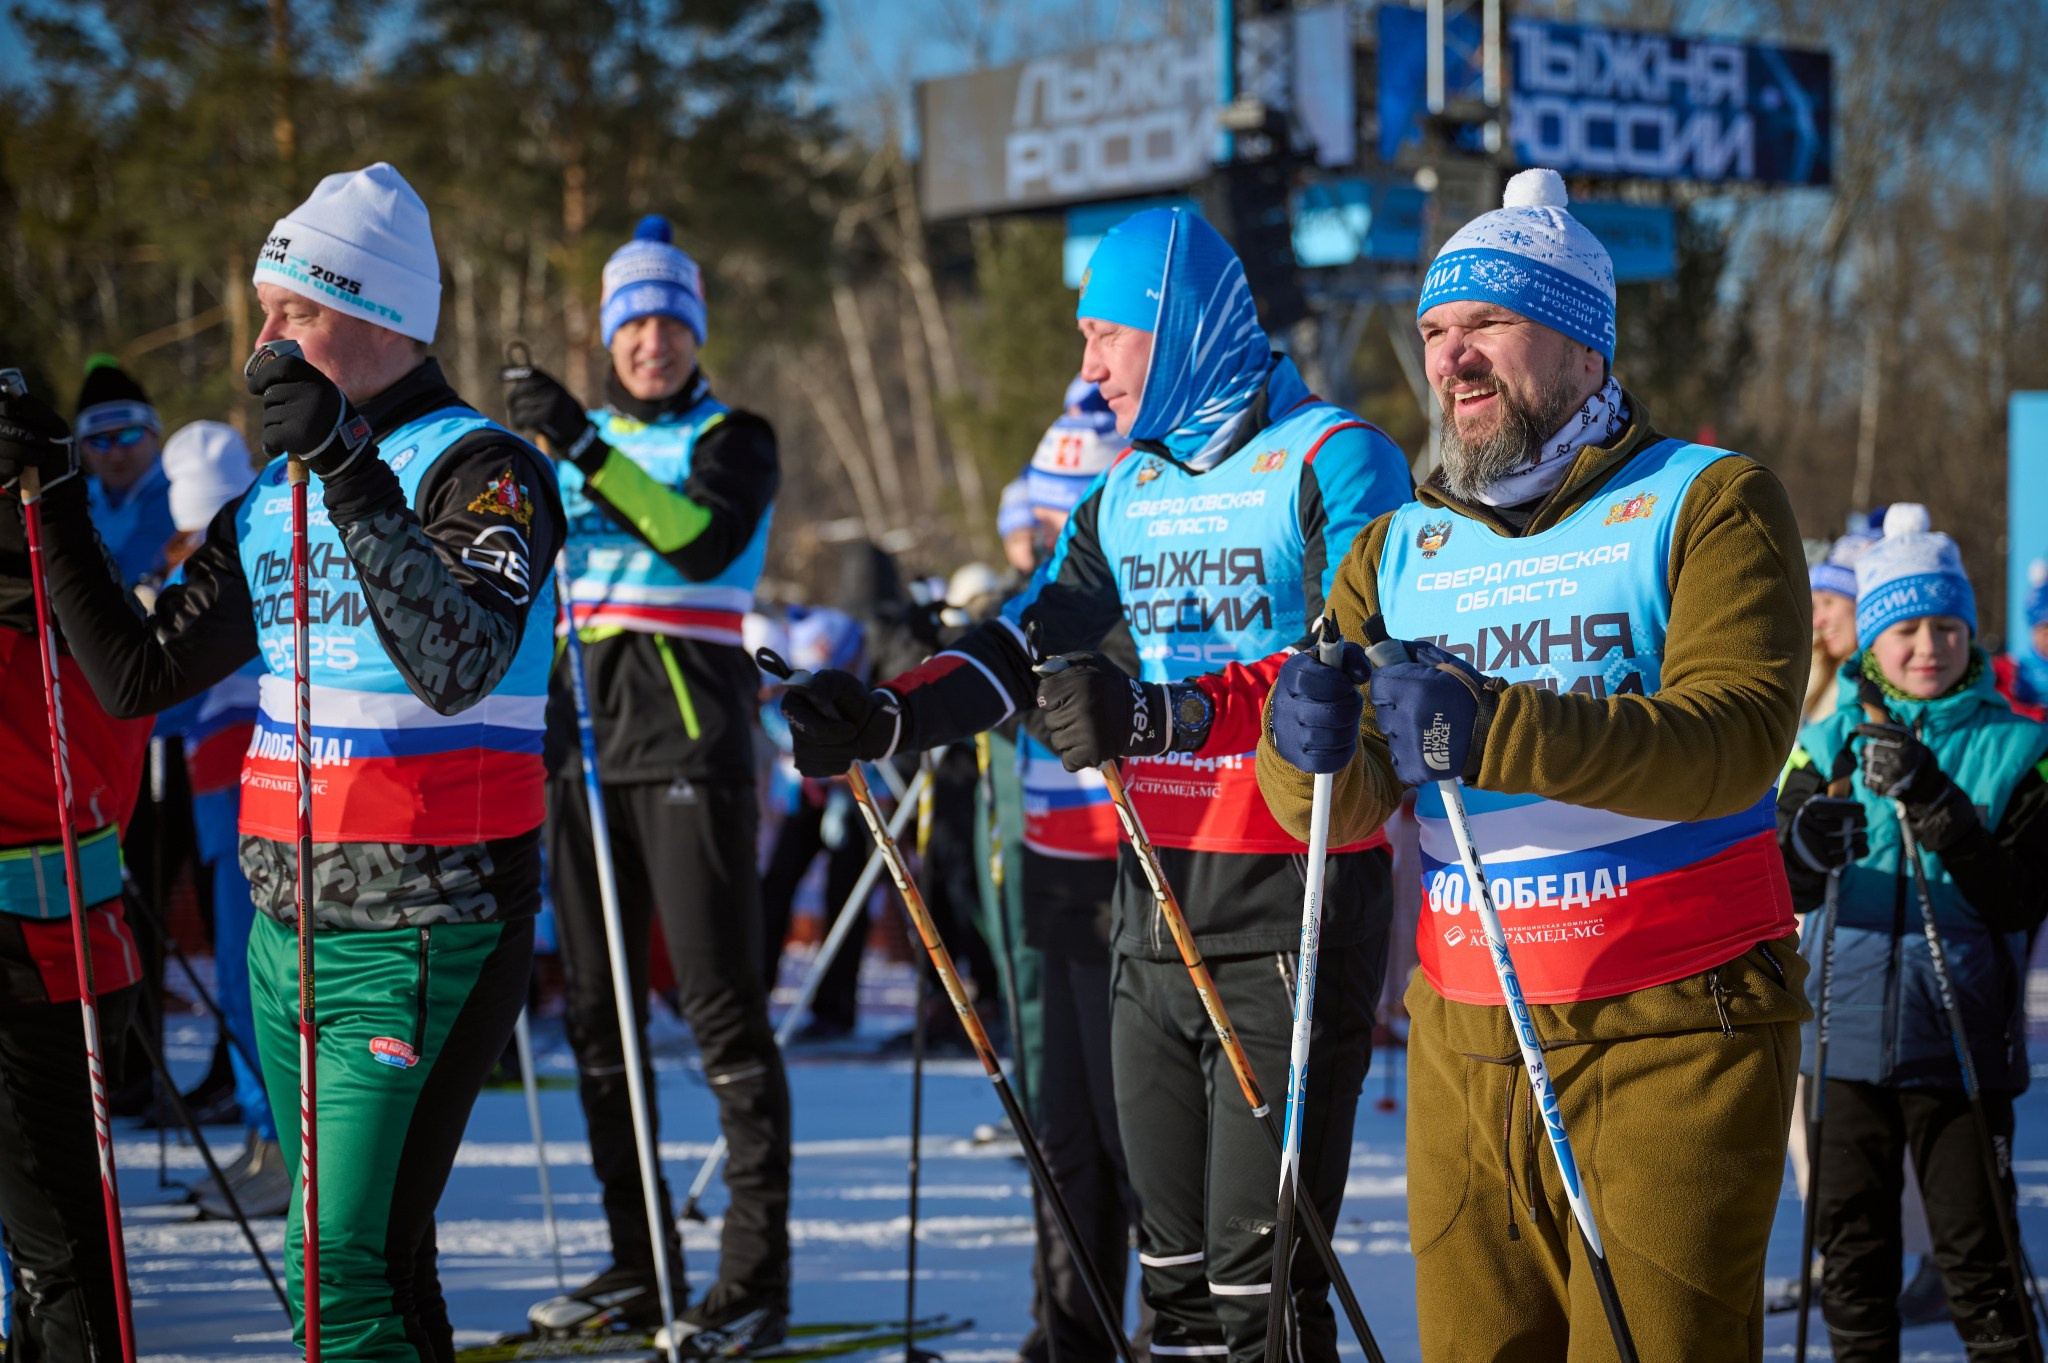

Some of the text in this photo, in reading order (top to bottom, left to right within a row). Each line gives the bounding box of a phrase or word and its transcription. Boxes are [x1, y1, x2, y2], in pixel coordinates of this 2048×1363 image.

[1511, 101, 1755, 181] ОССИИ
[309, 264, 362, 295] 2025
[1424, 264, 1462, 293] ИИ
[1542, 294, 1593, 326] РОССИИ
[1126, 490, 1266, 518] СВЕРДЛОВСКАЯ
[1147, 515, 1229, 538] ОБЛАСТЬ
[1120, 547, 1267, 591] ЛЫЖНЯ
[1416, 542, 1631, 592] СВЕРДЛОВСКАЯ
[1456, 578, 1578, 613] ОБЛАСТЬ
[1423, 729, 1433, 751] THE
[1431, 712, 1443, 751] NORTH
[1440, 723, 1450, 750] FACE
[1133, 780, 1222, 798] АСТРАМЕД-МС
[1428, 870, 1464, 915] 80
[1303, 891, 1316, 986] COMPOSITE SHAFT
[1469, 924, 1605, 947] АСРАМЕД-МС
[1508, 923, 1560, 933] МЕДИЦИНСКАЯ
[1562, 918, 1603, 927] КОМПАНИЯ
[1490, 937, 1540, 1050] X600
